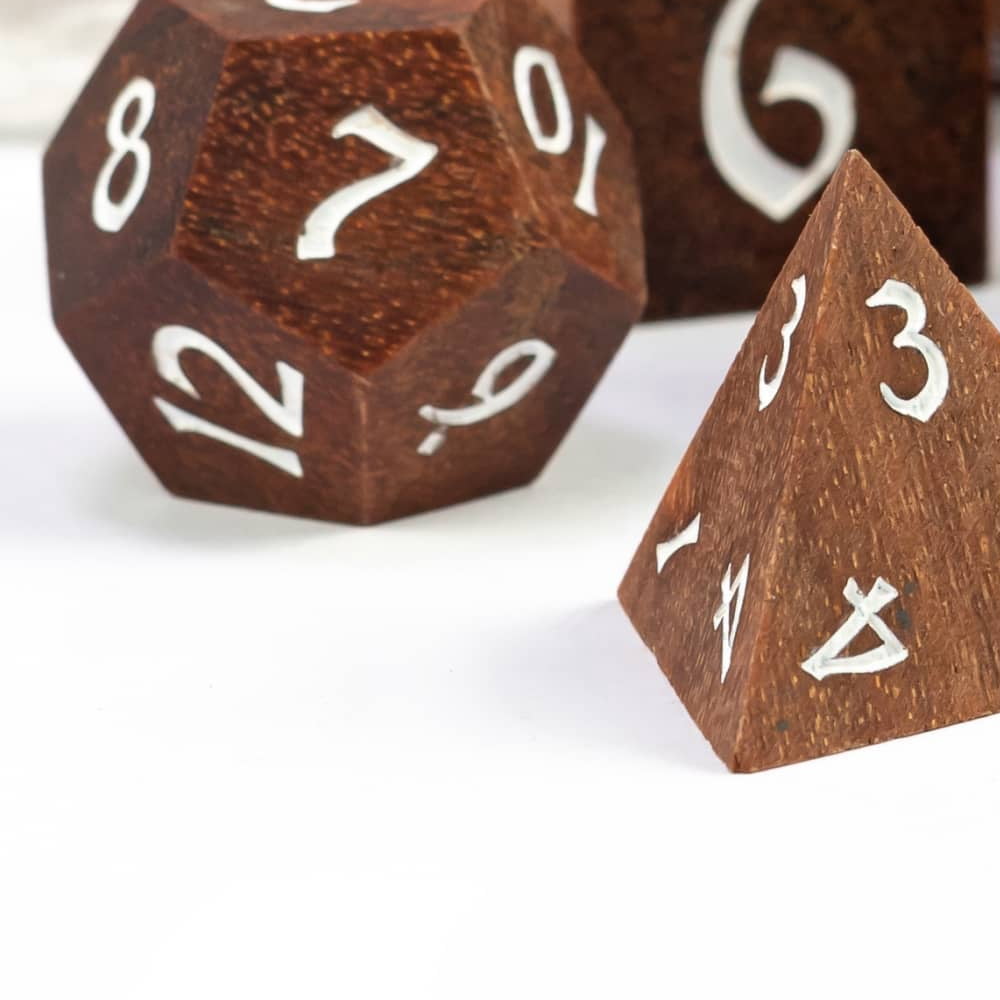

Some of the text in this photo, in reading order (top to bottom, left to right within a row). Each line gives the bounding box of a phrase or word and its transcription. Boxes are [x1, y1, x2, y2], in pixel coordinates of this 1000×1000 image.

[92, 77, 156, 233] 8
[297, 105, 439, 260] 7
[513, 45, 607, 217] 10
[151, 324, 305, 478] 12
[865, 278, 950, 423] 3
[800, 575, 909, 681] 4
